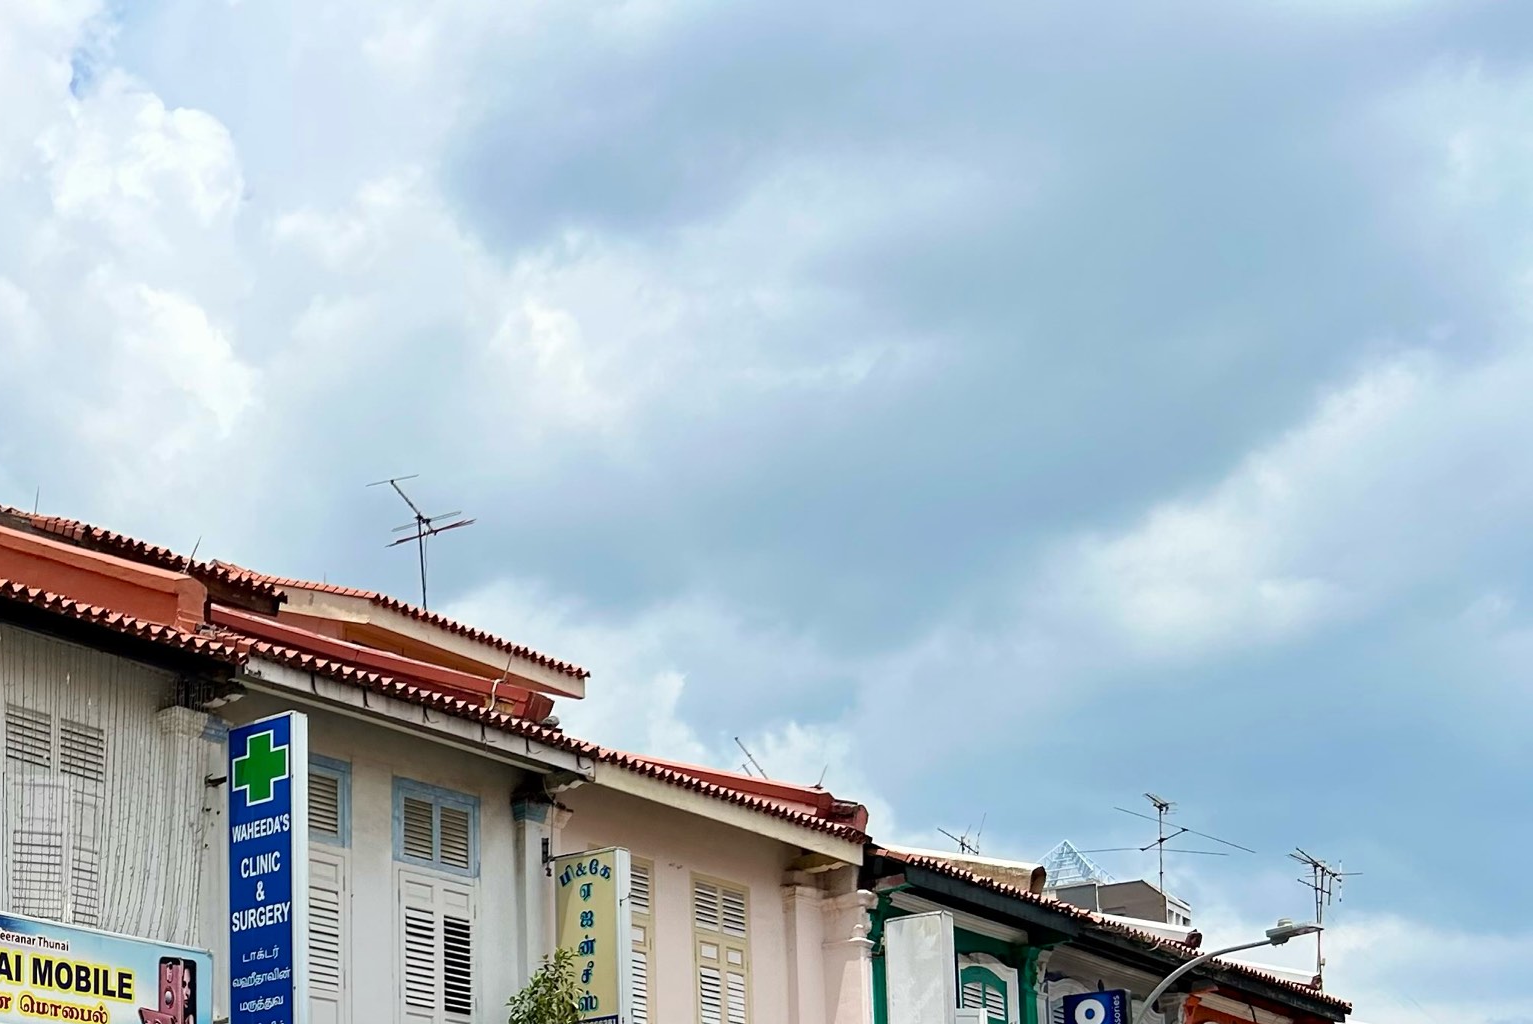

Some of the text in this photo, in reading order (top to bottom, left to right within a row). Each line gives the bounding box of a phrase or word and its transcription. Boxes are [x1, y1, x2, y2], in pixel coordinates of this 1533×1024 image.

[231, 813, 290, 844] WAHEEDA'S
[241, 851, 281, 880] CLINIC
[255, 880, 265, 902] &
[231, 901, 291, 933] SURGERY
[37, 937, 69, 951] Thunai
[242, 945, 280, 964] டாக்டர்
[32, 957, 133, 1000] MOBILE
[20, 994, 108, 1024] மொபைல்
[239, 994, 284, 1013] மருத்துவ
